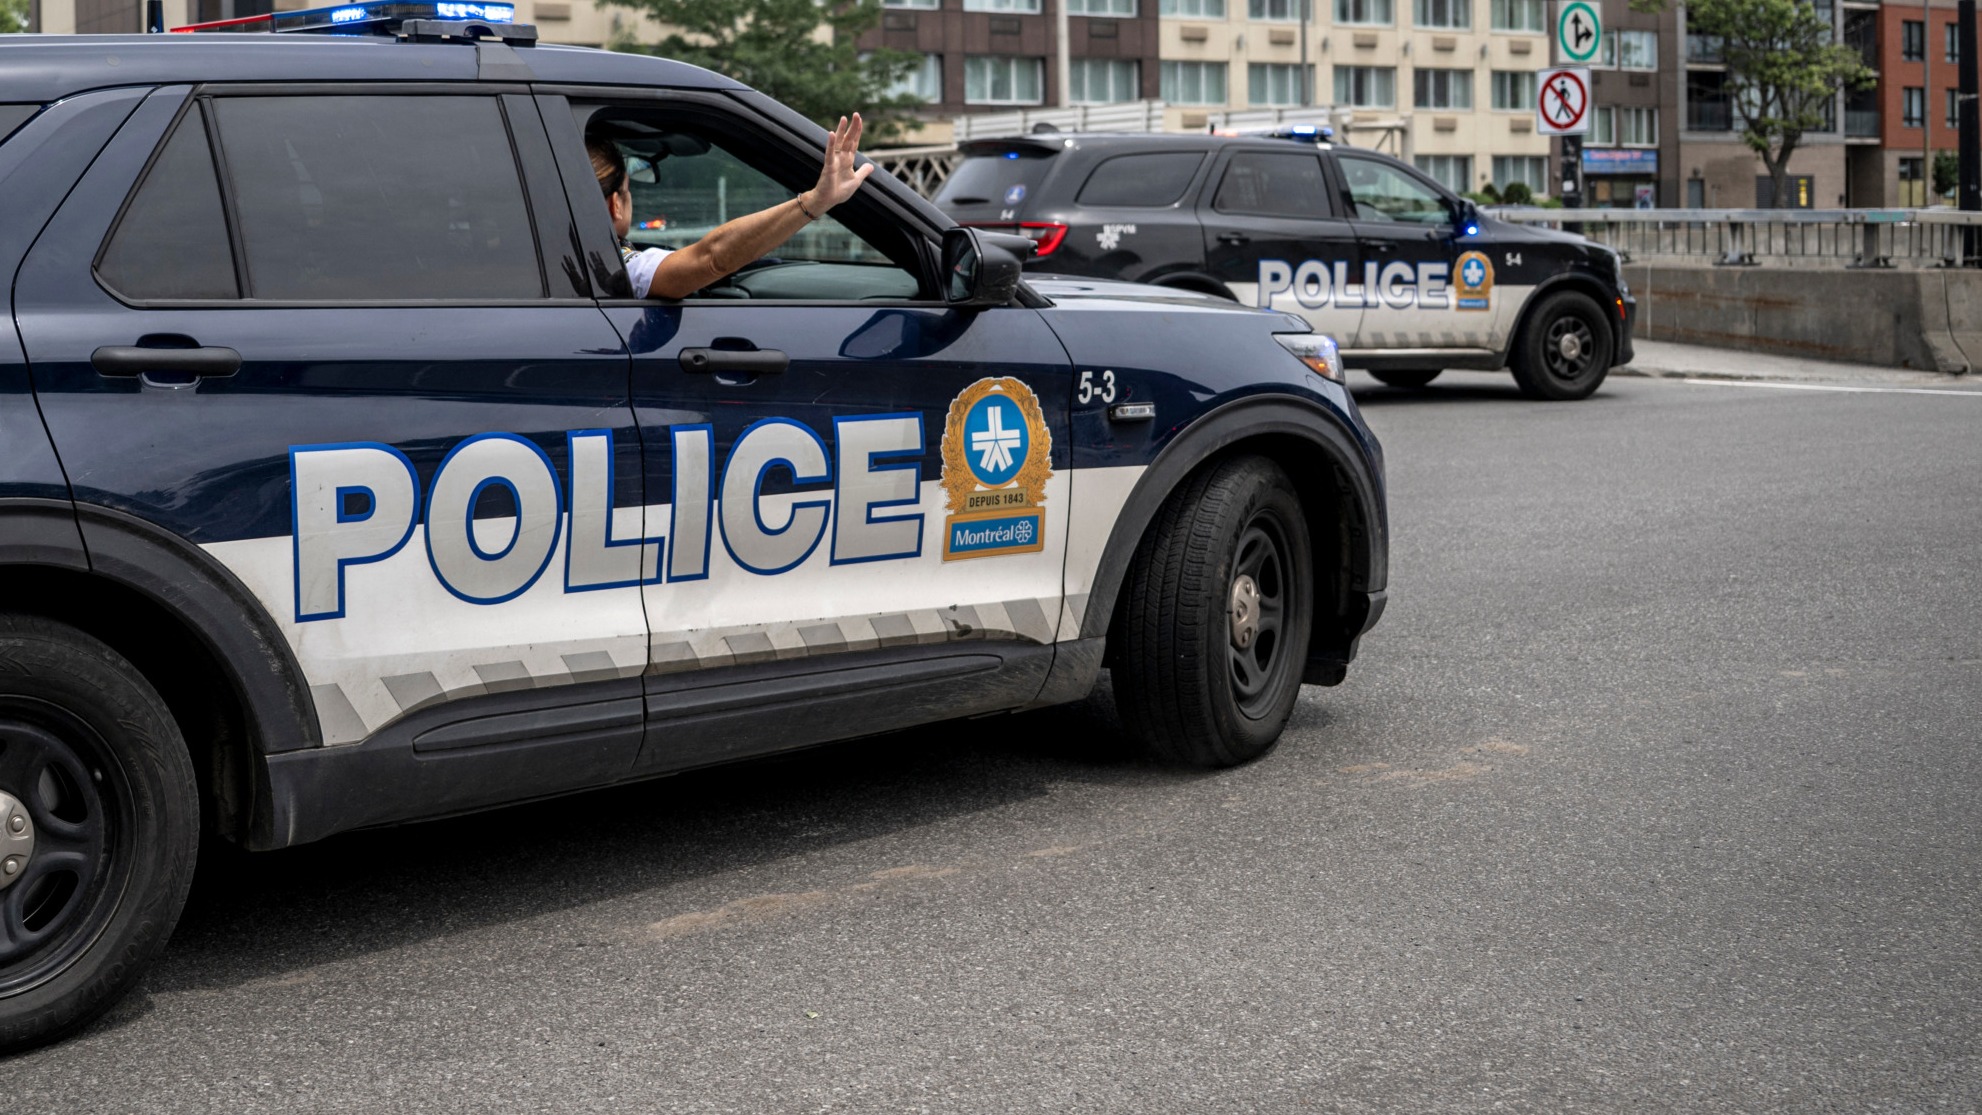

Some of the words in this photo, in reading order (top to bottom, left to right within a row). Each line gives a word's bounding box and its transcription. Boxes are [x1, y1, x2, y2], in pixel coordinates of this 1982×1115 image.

[1257, 258, 1450, 310] POLICE
[1078, 369, 1116, 404] 5-3
[289, 411, 926, 623] POLICE
[969, 494, 1000, 508] DEPUIS
[1003, 493, 1024, 504] 1843
[955, 525, 1014, 547] Montréal
